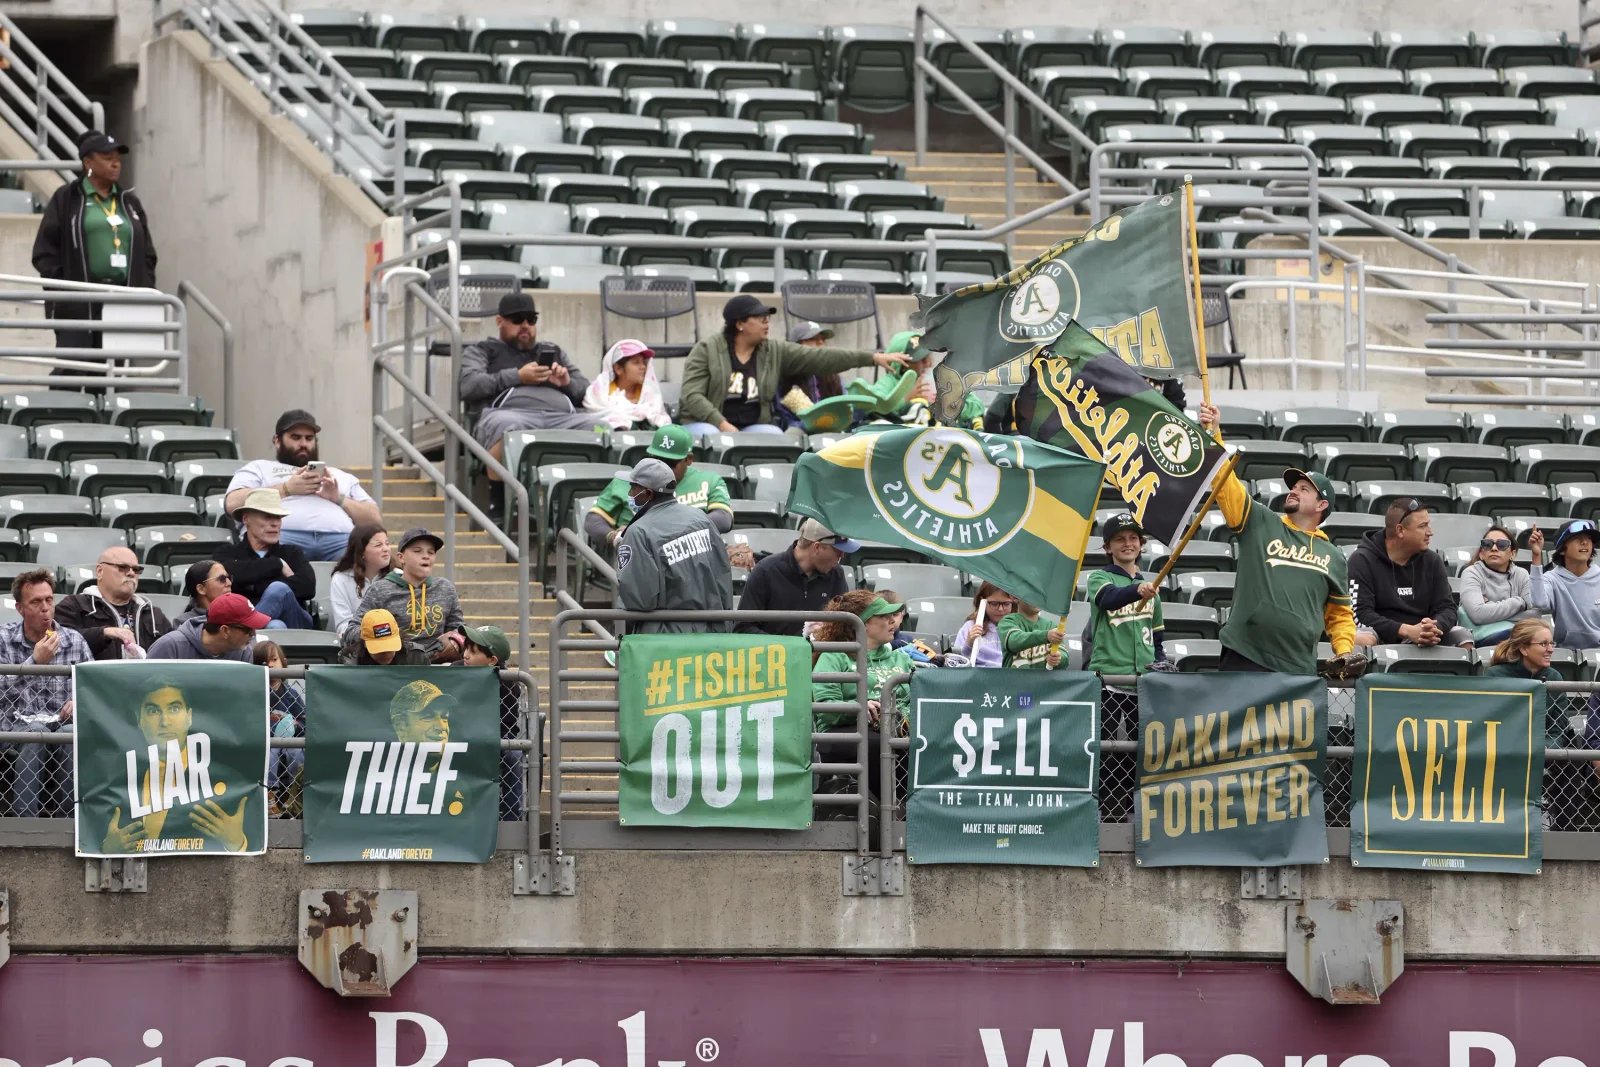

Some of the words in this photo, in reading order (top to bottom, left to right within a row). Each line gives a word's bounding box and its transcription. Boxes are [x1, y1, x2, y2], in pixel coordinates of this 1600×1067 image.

[1266, 538, 1331, 568] Oakland
[645, 643, 787, 706] #FISHER
[651, 699, 785, 815] OUT
[952, 713, 1059, 778] $E.LL
[1143, 698, 1315, 773] OAKLAND
[126, 732, 227, 819] LIAR.
[339, 741, 468, 816] THIEF.
[938, 791, 963, 806] THE
[977, 792, 1019, 809] TEAM,
[1027, 793, 1070, 808] JOHN.
[1391, 716, 1506, 824] SELL
[962, 823, 982, 834] MAKE
[983, 823, 996, 834] THE
[997, 824, 1017, 835] RIGHT
[1018, 824, 1045, 835] CHOICE.
[1140, 764, 1311, 842] FOREVER
[136, 838, 204, 852] #OAKLANDFOREVER
[361, 848, 433, 860] #OAKLANDFOREVER
